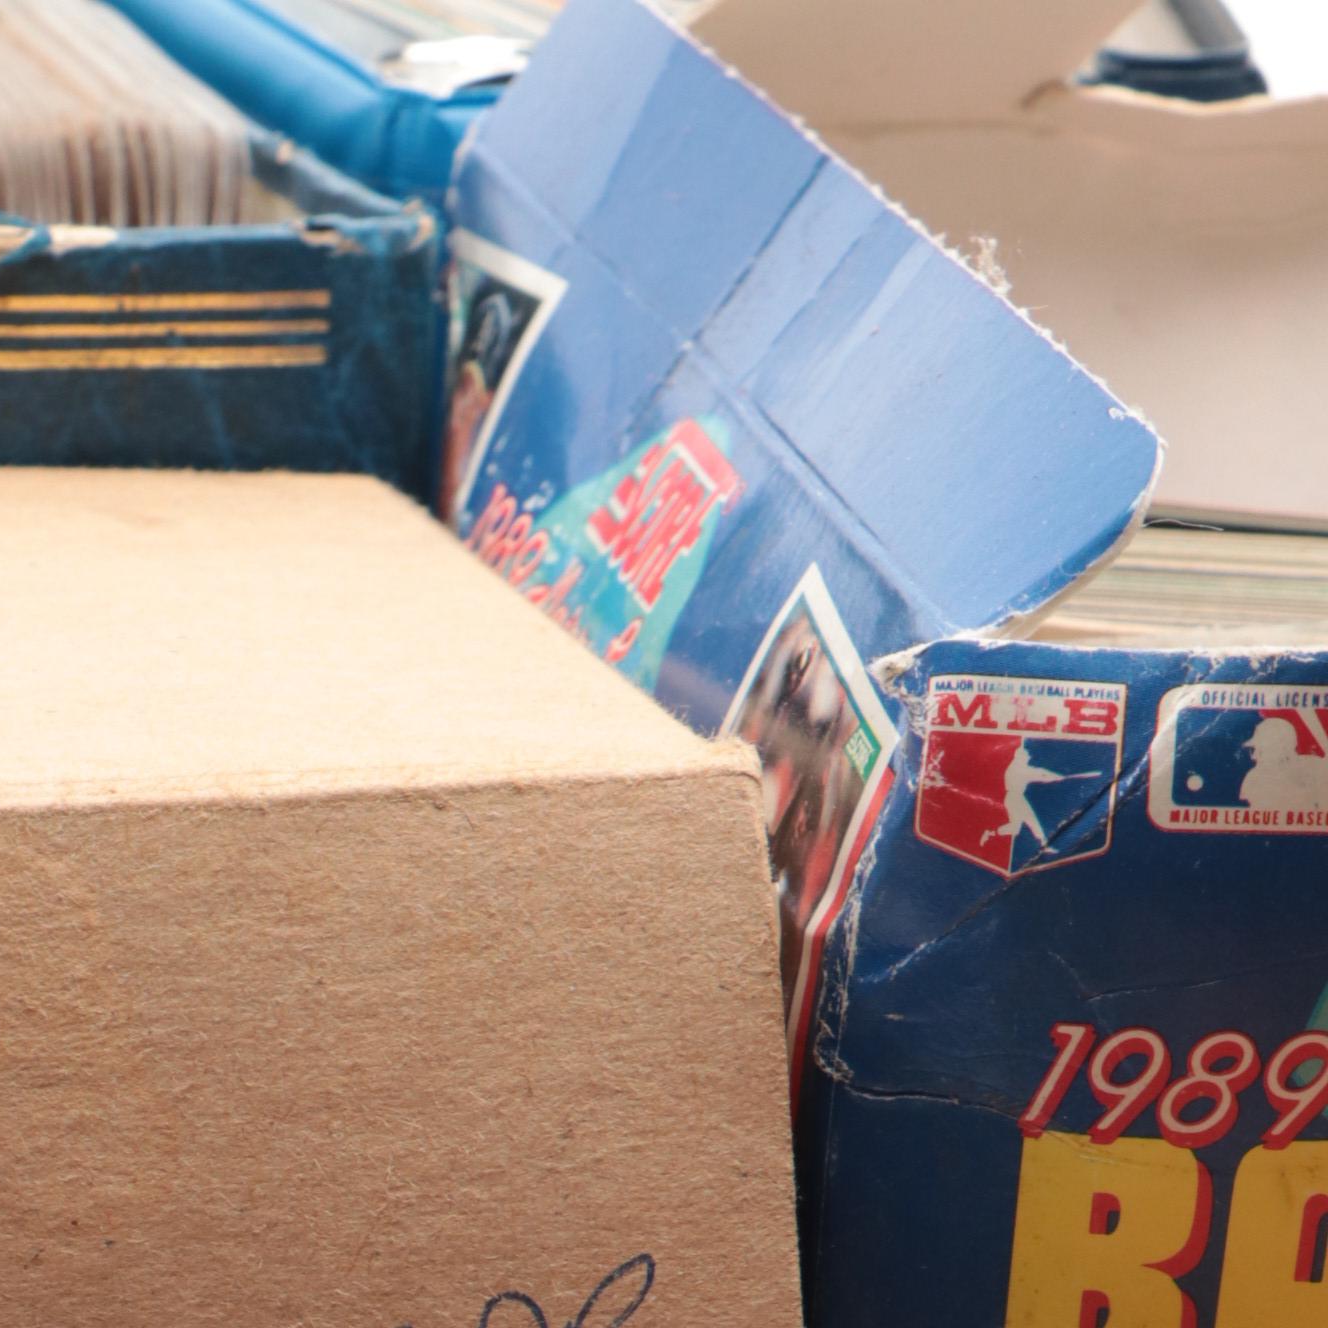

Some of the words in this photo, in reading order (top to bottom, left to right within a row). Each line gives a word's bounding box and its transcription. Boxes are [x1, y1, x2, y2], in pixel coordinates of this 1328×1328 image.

[934, 679, 974, 692] MAJOR
[1074, 687, 1120, 701] PLAYERS
[1202, 690, 1266, 707] OFFICIAL
[930, 692, 1120, 736] MLB
[1169, 809, 1219, 824] MAJOR
[1224, 810, 1280, 825] LEAGUE
[1018, 1020, 1328, 1150] 1989
